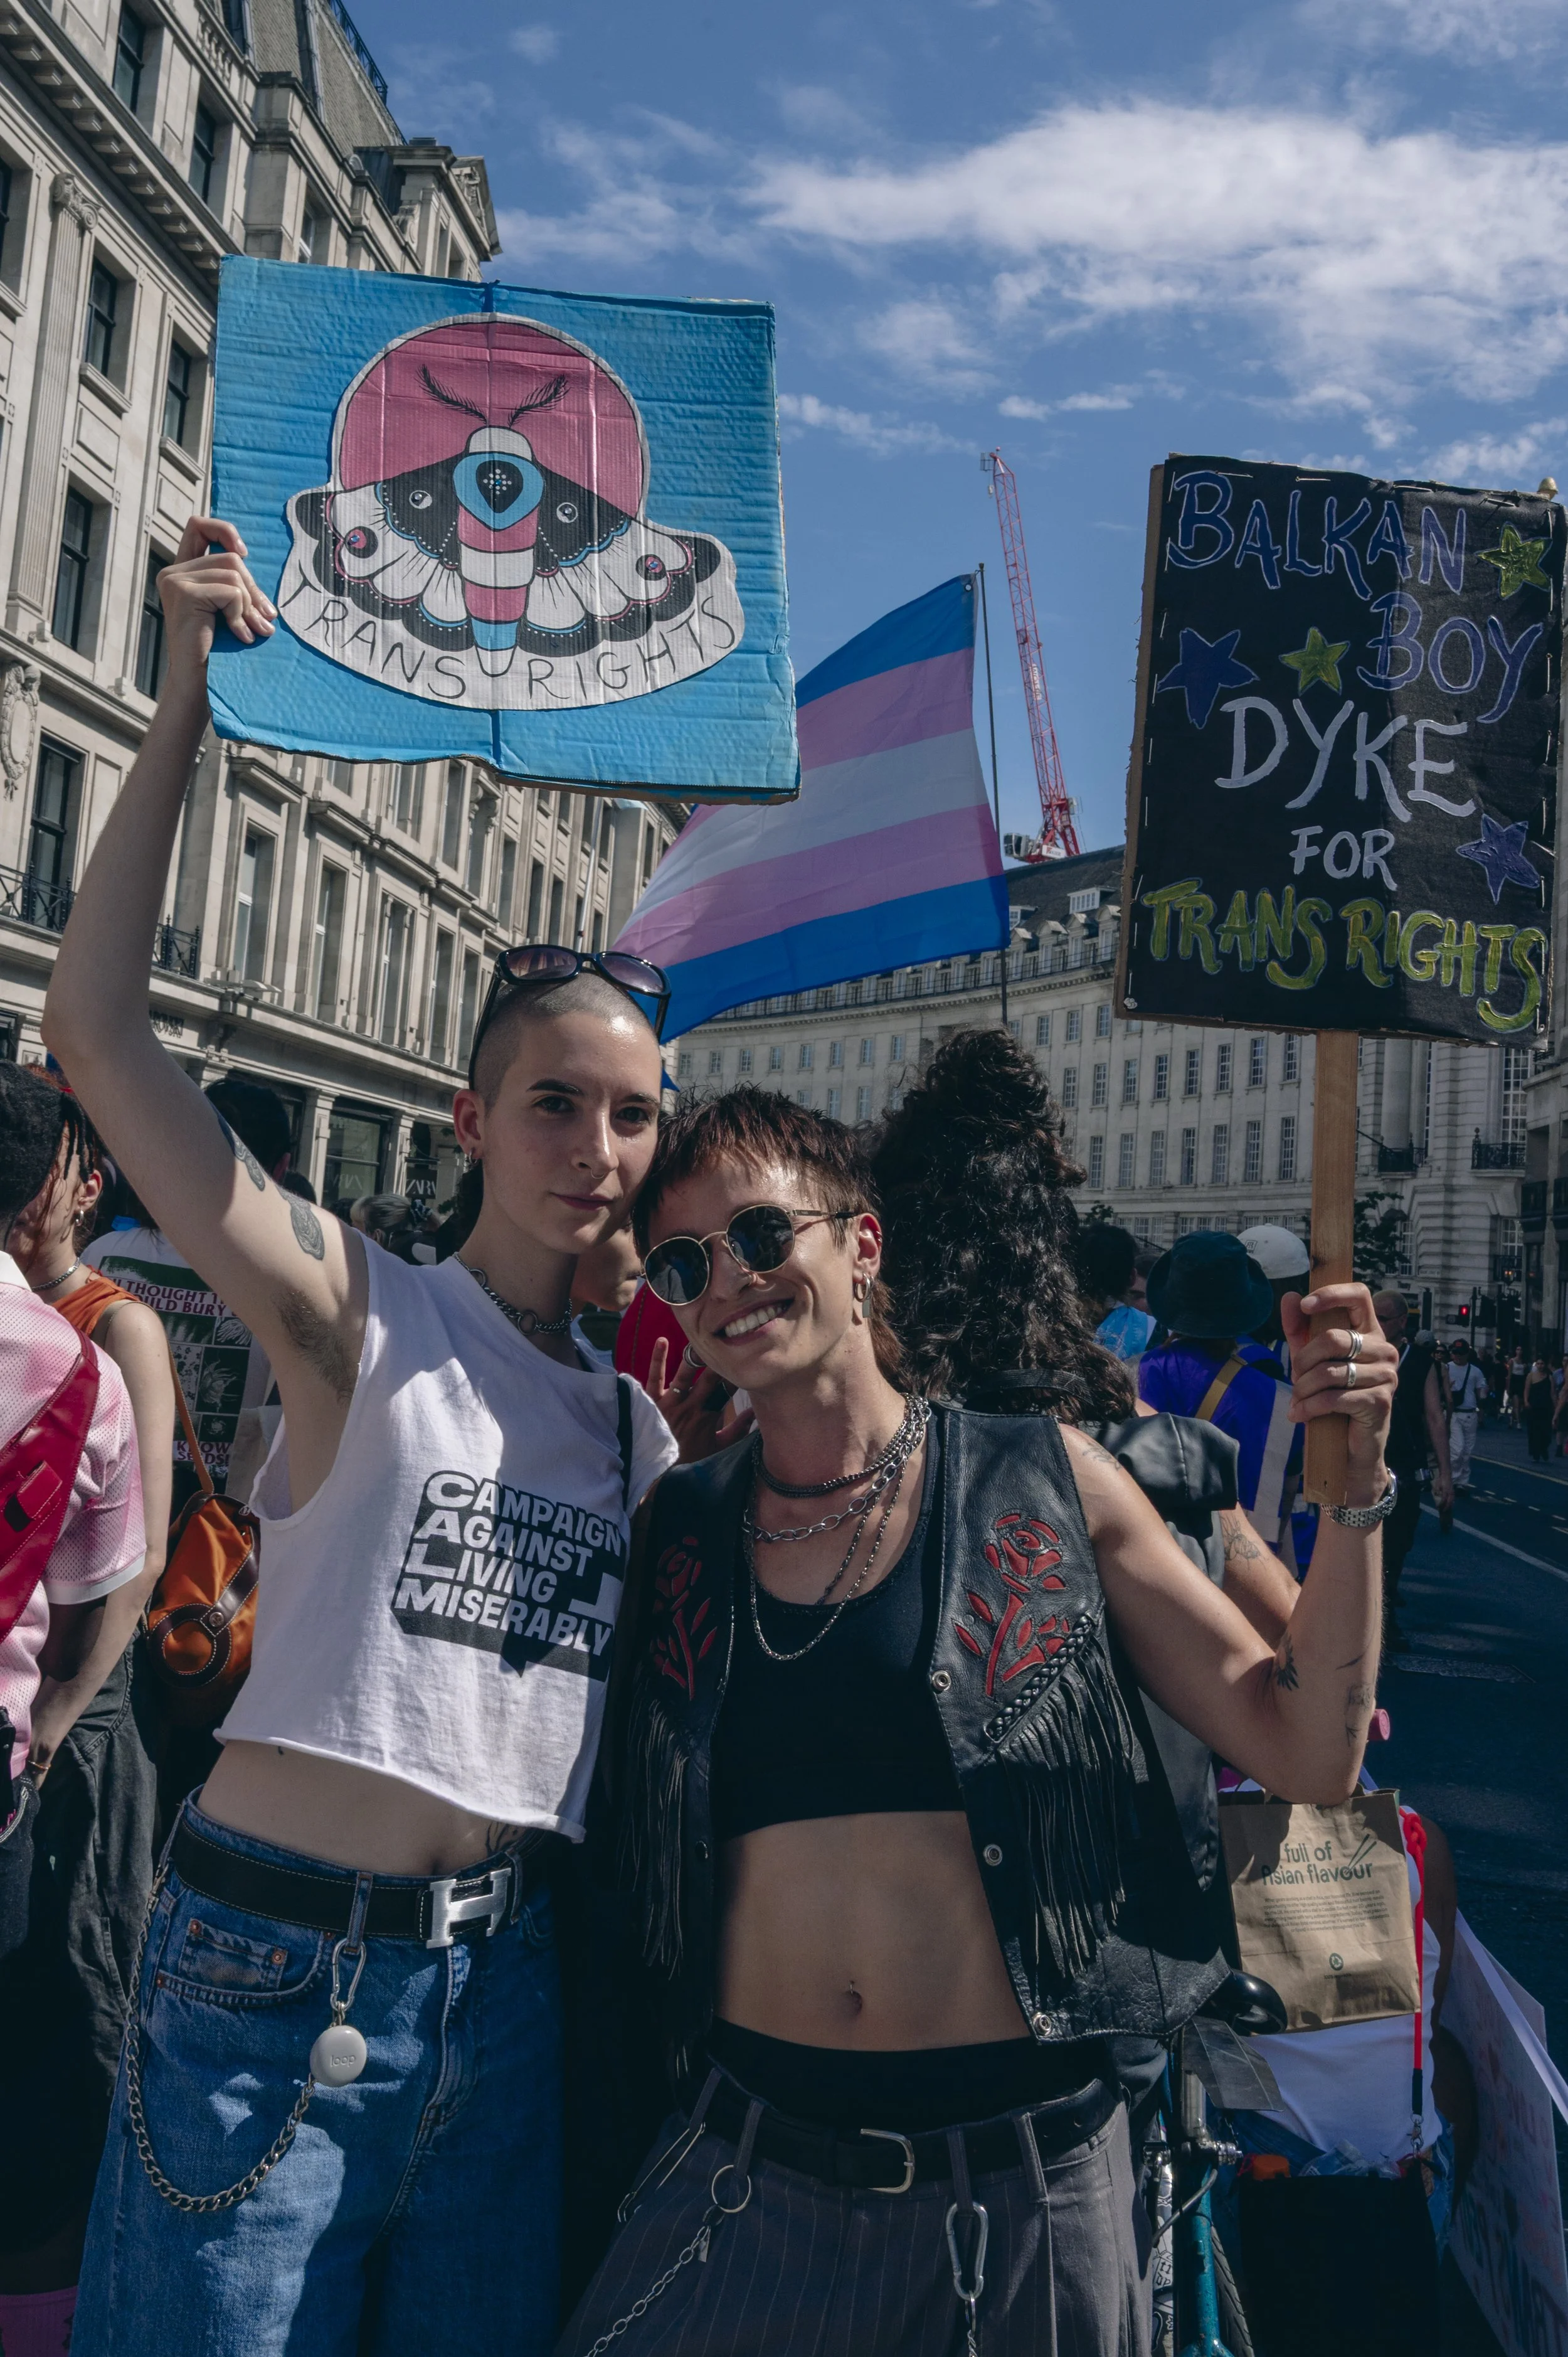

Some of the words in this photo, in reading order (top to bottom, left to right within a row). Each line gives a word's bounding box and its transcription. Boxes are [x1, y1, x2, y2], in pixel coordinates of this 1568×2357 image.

[1168, 471, 1466, 600] BALKAN
[280, 560, 467, 699] TRANS
[529, 595, 736, 700] RIGHTS
[1357, 591, 1544, 723] BOY
[1214, 696, 1476, 822] DYKE
[1290, 825, 1398, 891] FOR
[1141, 878, 1332, 990] TRANS
[1339, 898, 1547, 1033] RIGHTS
[127, 1280, 208, 1304] THOUGHT
[183, 1301, 226, 1316] BURY
[177, 1451, 230, 1467] SEDS!
[413, 1509, 593, 1577] AGAINST
[426, 1472, 621, 1557] CAMPAIGN
[405, 1543, 558, 1604] LIVING
[395, 1577, 612, 1656] MISERABLY
[1261, 1865, 1305, 1885] Asian
[1306, 1863, 1373, 1883] flavour
[1284, 1843, 1310, 1863] full
[1314, 1841, 1332, 1861] of
[330, 2055, 356, 2068] loop
